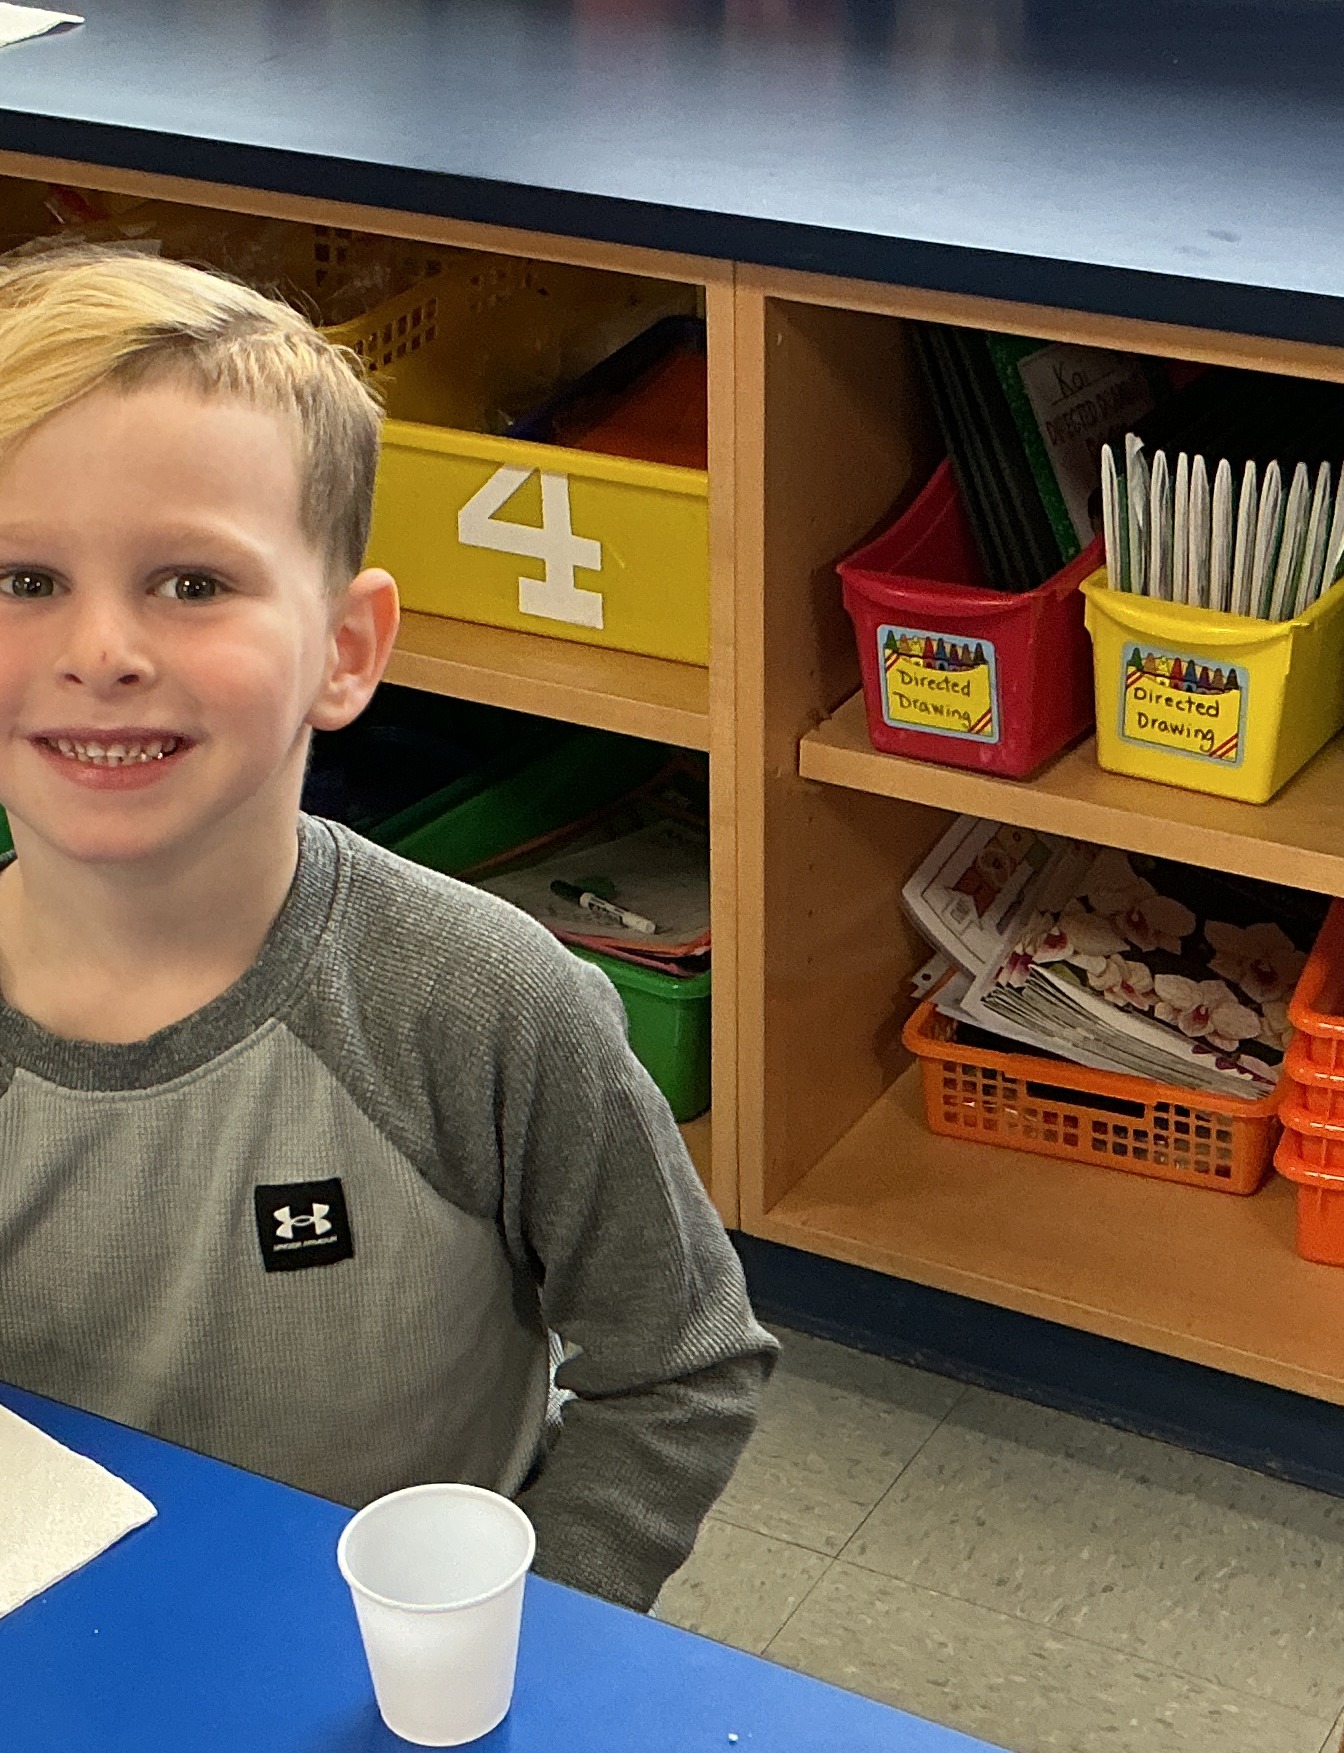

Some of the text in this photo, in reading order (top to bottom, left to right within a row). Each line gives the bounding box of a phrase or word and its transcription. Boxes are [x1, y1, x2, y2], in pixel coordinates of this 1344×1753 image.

[457, 463, 604, 630] 4
[895, 668, 971, 698] Directed
[1133, 686, 1220, 718] Directed
[892, 690, 973, 729] Drawing
[1137, 711, 1215, 752] Drawing
